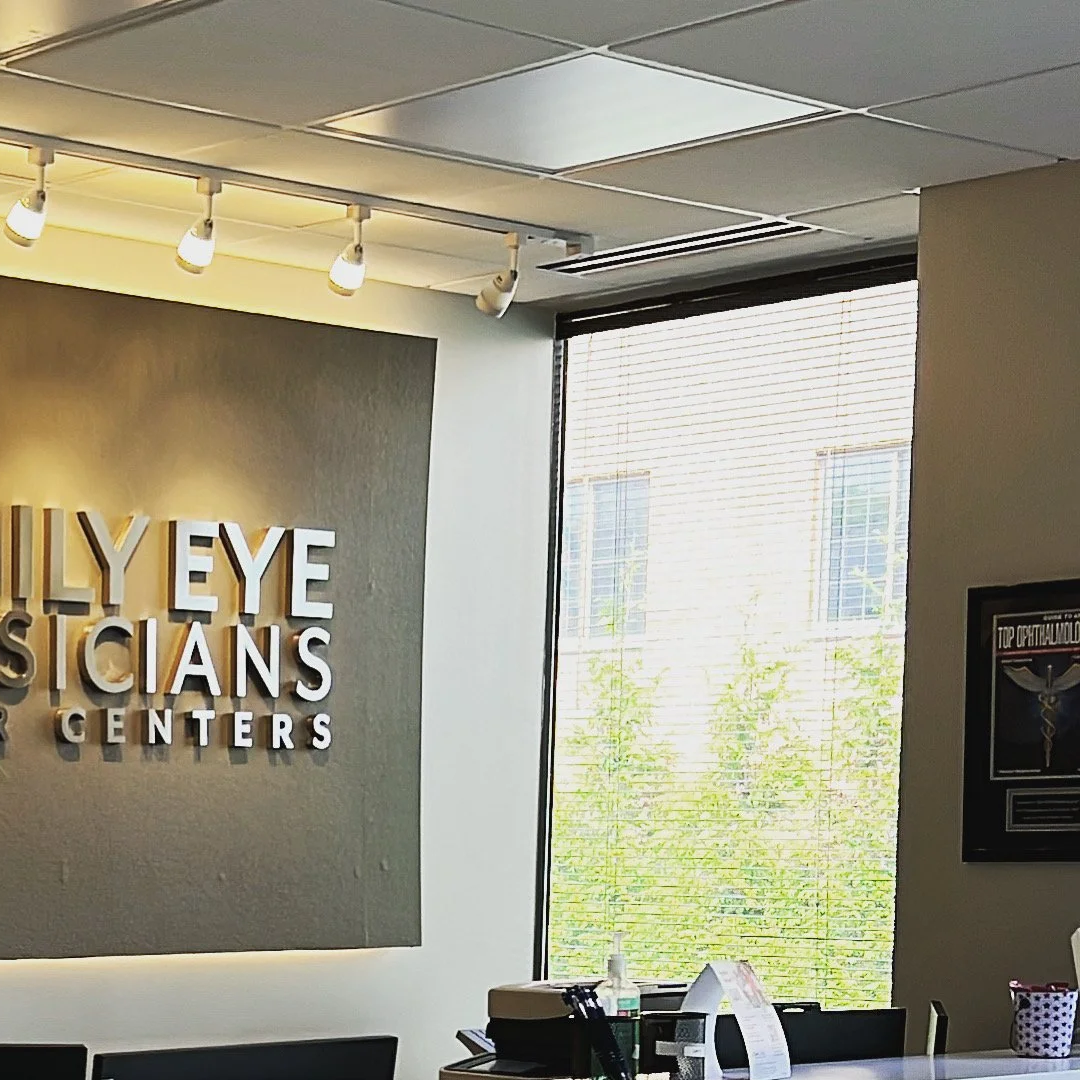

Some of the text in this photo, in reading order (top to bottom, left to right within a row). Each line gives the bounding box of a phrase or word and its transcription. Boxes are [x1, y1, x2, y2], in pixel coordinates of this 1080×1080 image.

[169, 520, 336, 619] EYE
[998, 627, 1015, 649] TOP
[55, 706, 333, 749] CENTERS
